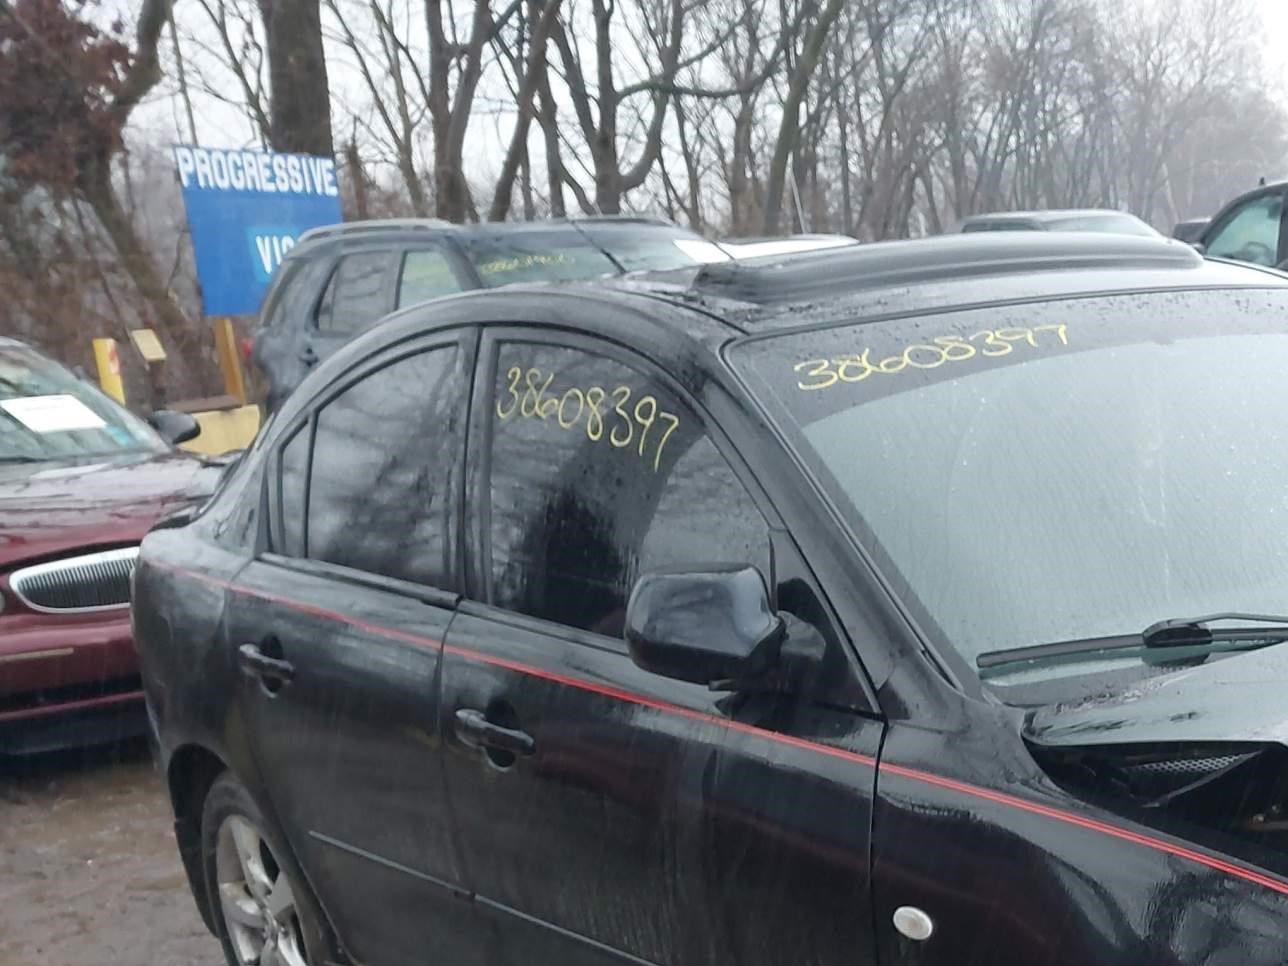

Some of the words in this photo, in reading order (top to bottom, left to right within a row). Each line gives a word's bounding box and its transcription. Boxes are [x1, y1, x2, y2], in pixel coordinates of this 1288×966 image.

[175, 147, 339, 197] PROGRESSIVE
[792, 323, 1068, 391] 38608397
[497, 366, 680, 473] 38608397
